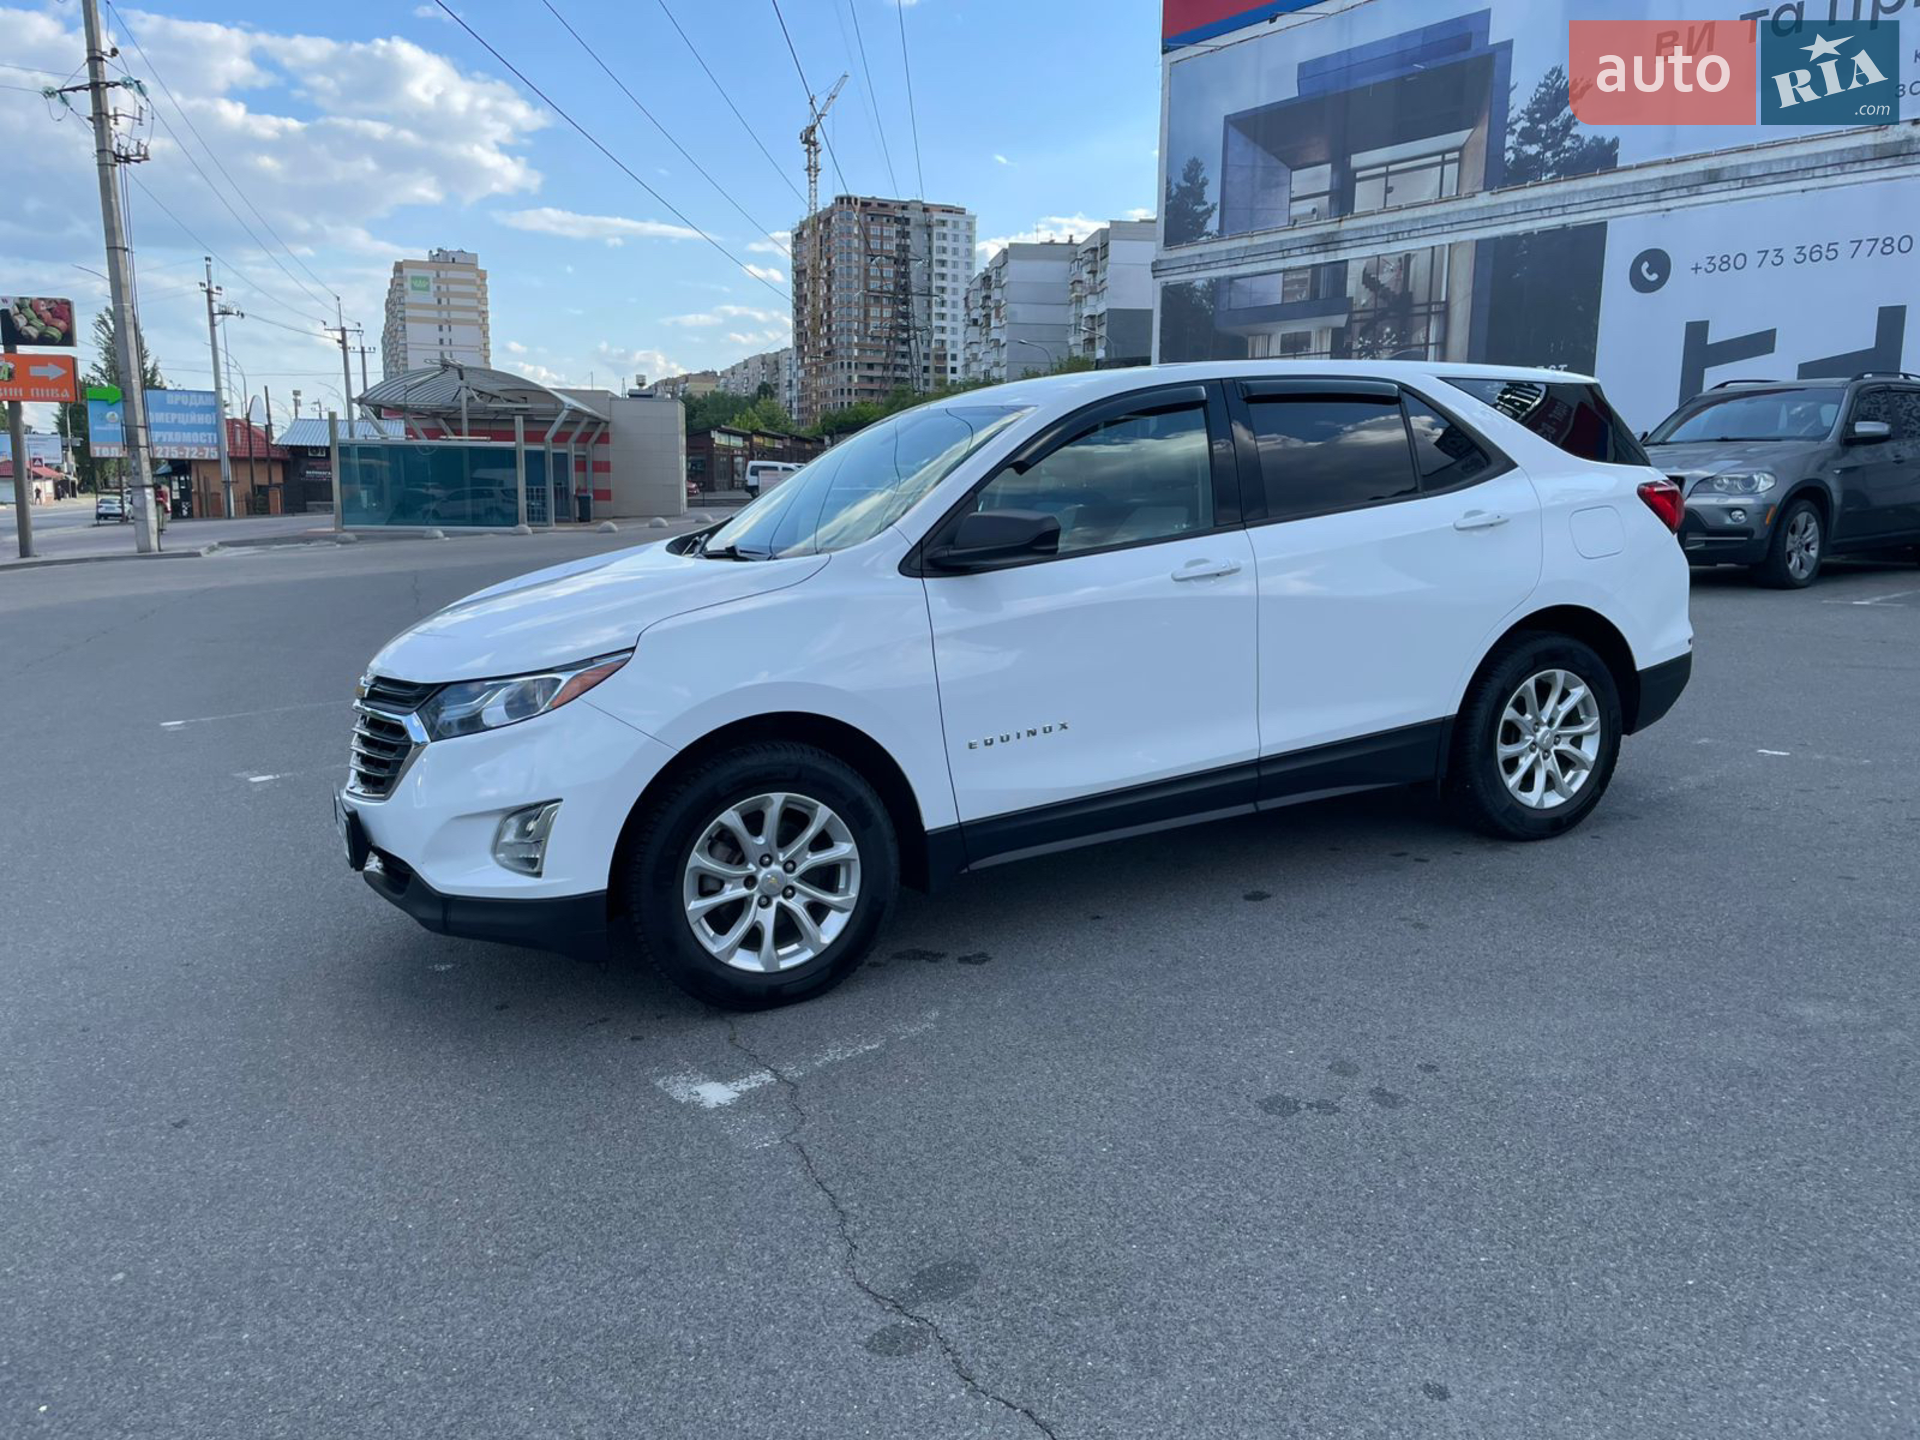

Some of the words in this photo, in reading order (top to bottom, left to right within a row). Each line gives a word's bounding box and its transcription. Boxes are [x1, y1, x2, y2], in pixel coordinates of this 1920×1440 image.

[1828, 0, 1920, 31] пр
[1691, 252, 1748, 275] +380
[1757, 247, 1784, 269] 73
[1793, 242, 1839, 264] 365
[1849, 234, 1914, 259] 7780
[149, 411, 216, 425] ОМЕРЦІЙНОЇ
[152, 431, 217, 443] РУХОМОСТІ
[155, 446, 218, 458] 275-72-75
[967, 721, 1069, 750] EQUINOX
